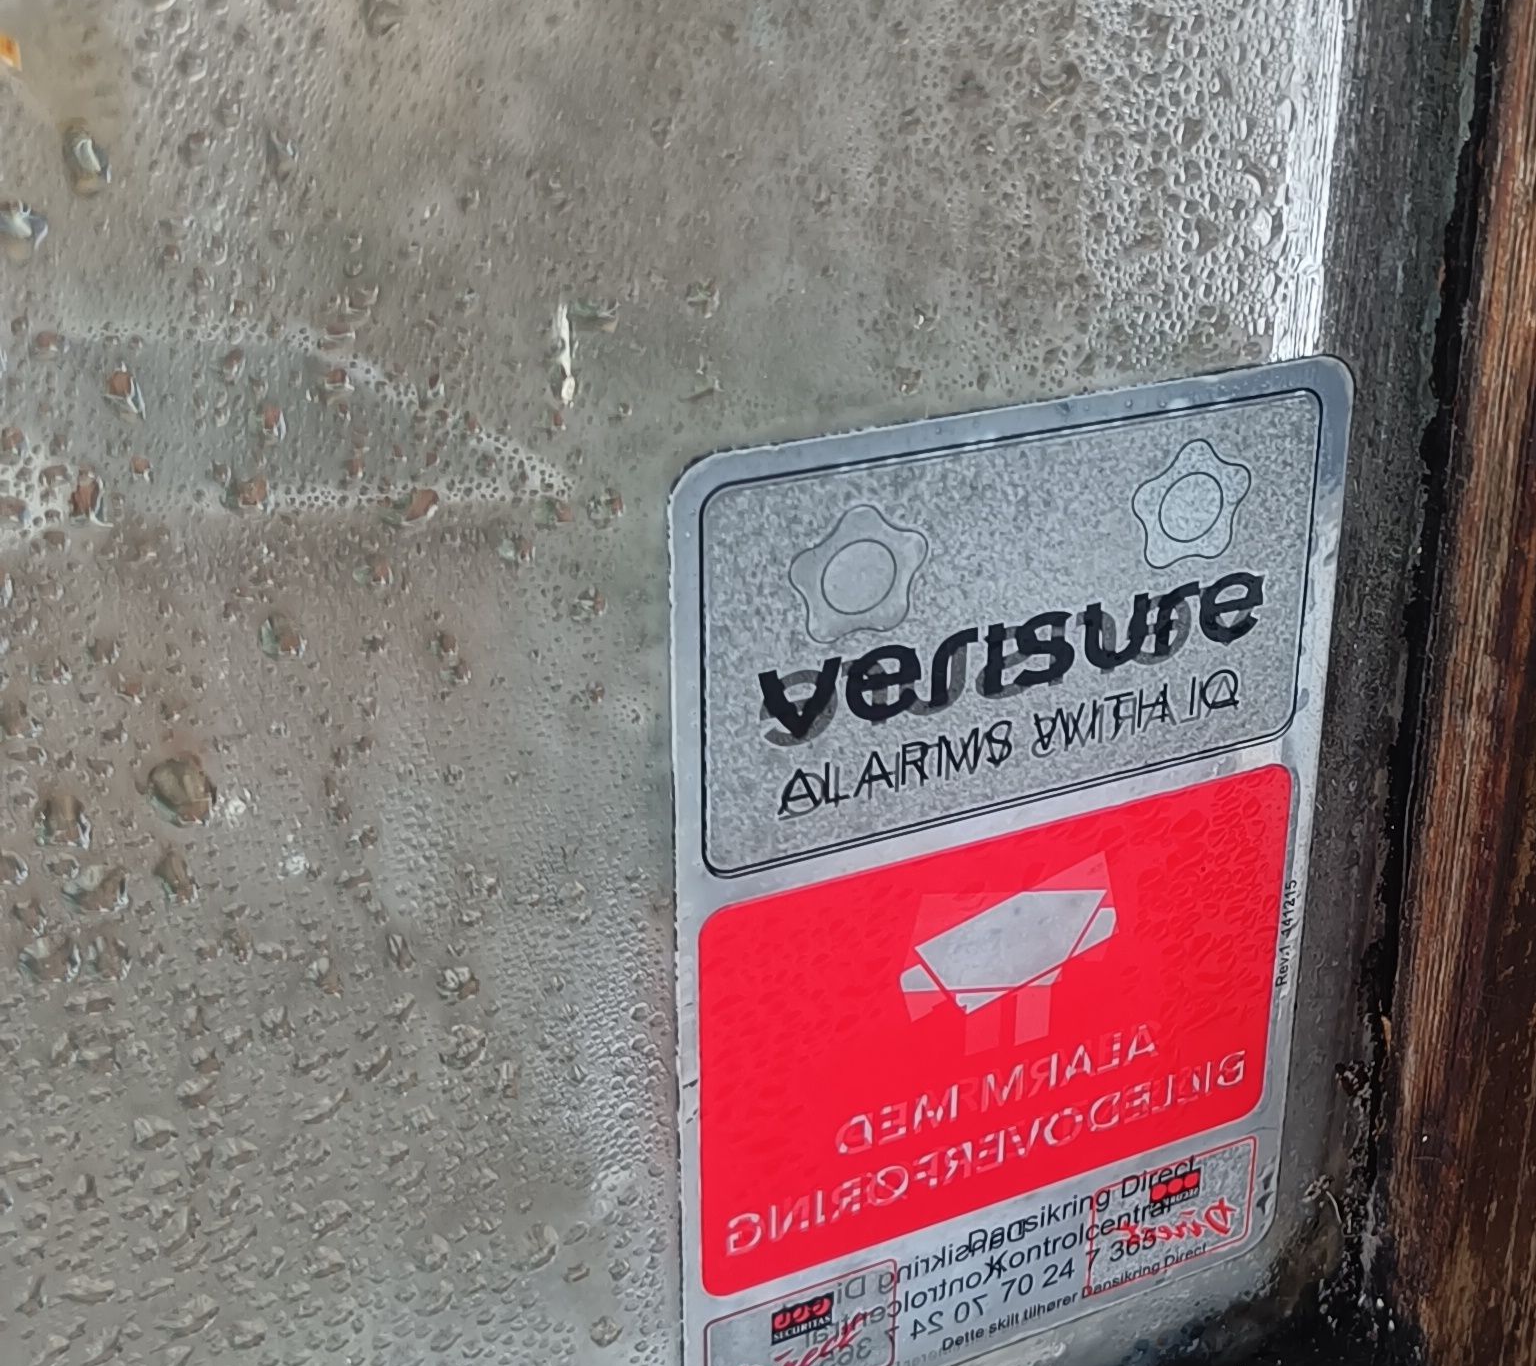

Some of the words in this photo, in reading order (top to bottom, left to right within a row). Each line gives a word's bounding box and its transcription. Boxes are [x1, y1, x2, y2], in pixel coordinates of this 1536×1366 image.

[758, 573, 1264, 735] verisure
[779, 721, 1013, 813] ALARMS
[1034, 683, 1169, 750] WITH
[1189, 669, 1239, 715] IQ
[1275, 945, 1291, 987] Rev.1
[968, 1188, 1110, 1254] Dansikring
[1121, 1155, 1196, 1199] Direct
[988, 1194, 1172, 1277] Kontrolcentral
[942, 1325, 985, 1351] Dette
[989, 1314, 1020, 1332] skilt
[1024, 1294, 1078, 1324] tilhører
[1081, 1261, 1160, 1301] Dansikring
[1164, 1243, 1207, 1266] Direct
[1001, 1273, 1033, 1303] 70
[1042, 1258, 1075, 1288] 24
[1110, 1231, 1157, 1263] 365
[773, 1315, 832, 1341] SECURITAS
